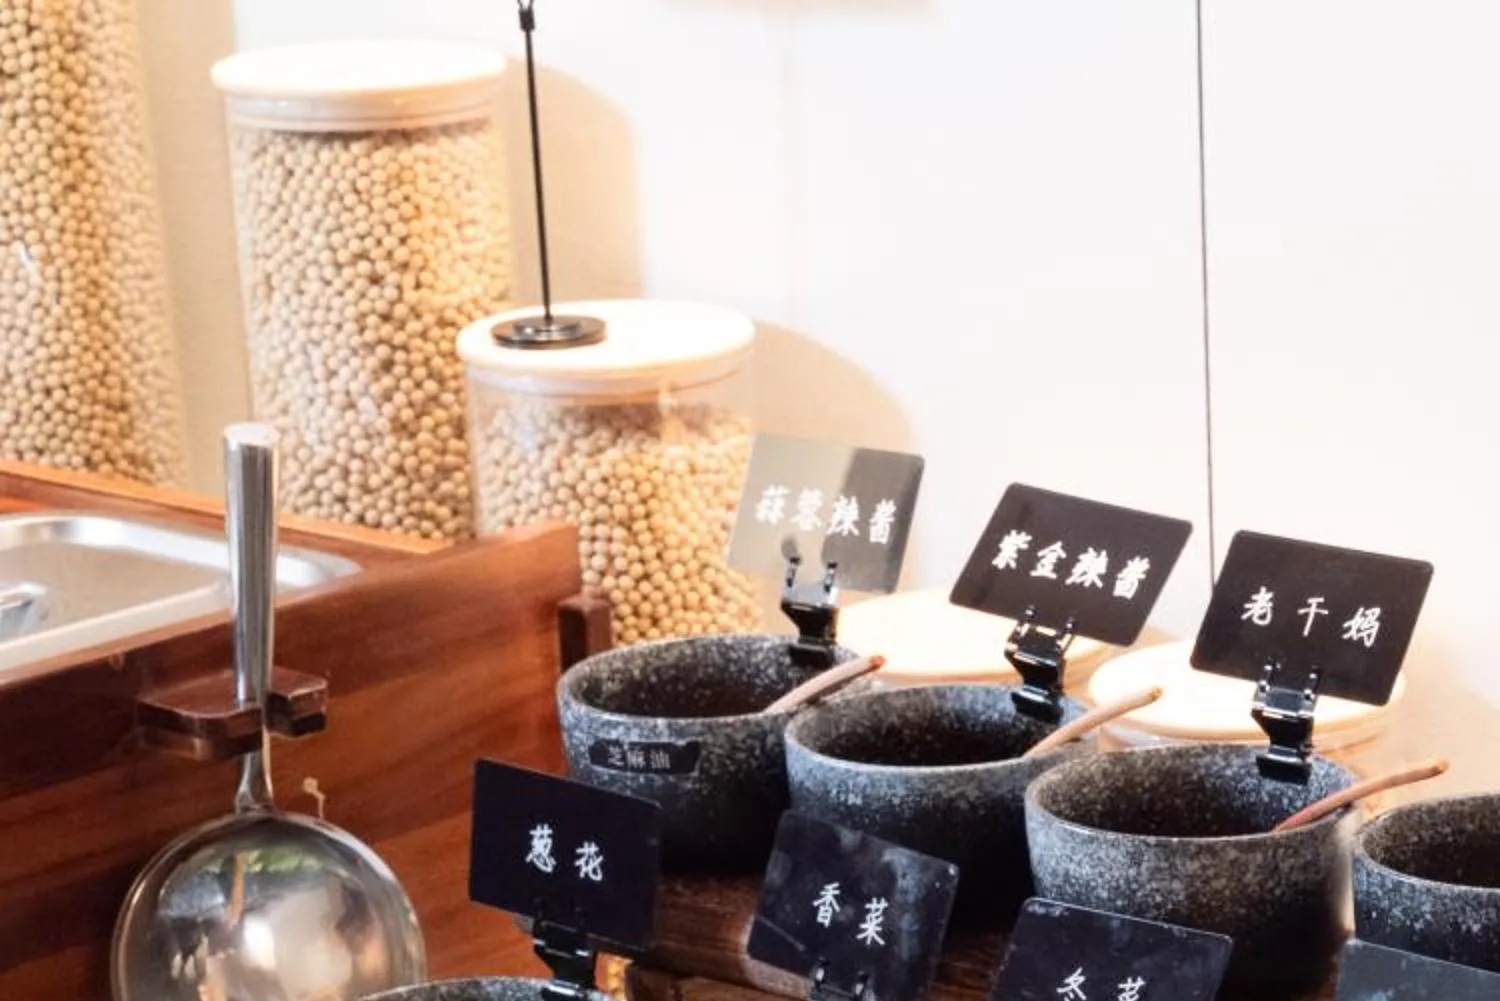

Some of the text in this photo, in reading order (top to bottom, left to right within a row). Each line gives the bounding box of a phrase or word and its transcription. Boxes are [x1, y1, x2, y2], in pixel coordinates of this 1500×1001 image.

[991, 529, 1151, 600] 紫金辣酱
[1240, 585, 1382, 648] 老干妈
[525, 823, 604, 882] 葱花
[812, 881, 890, 946] 香菜
